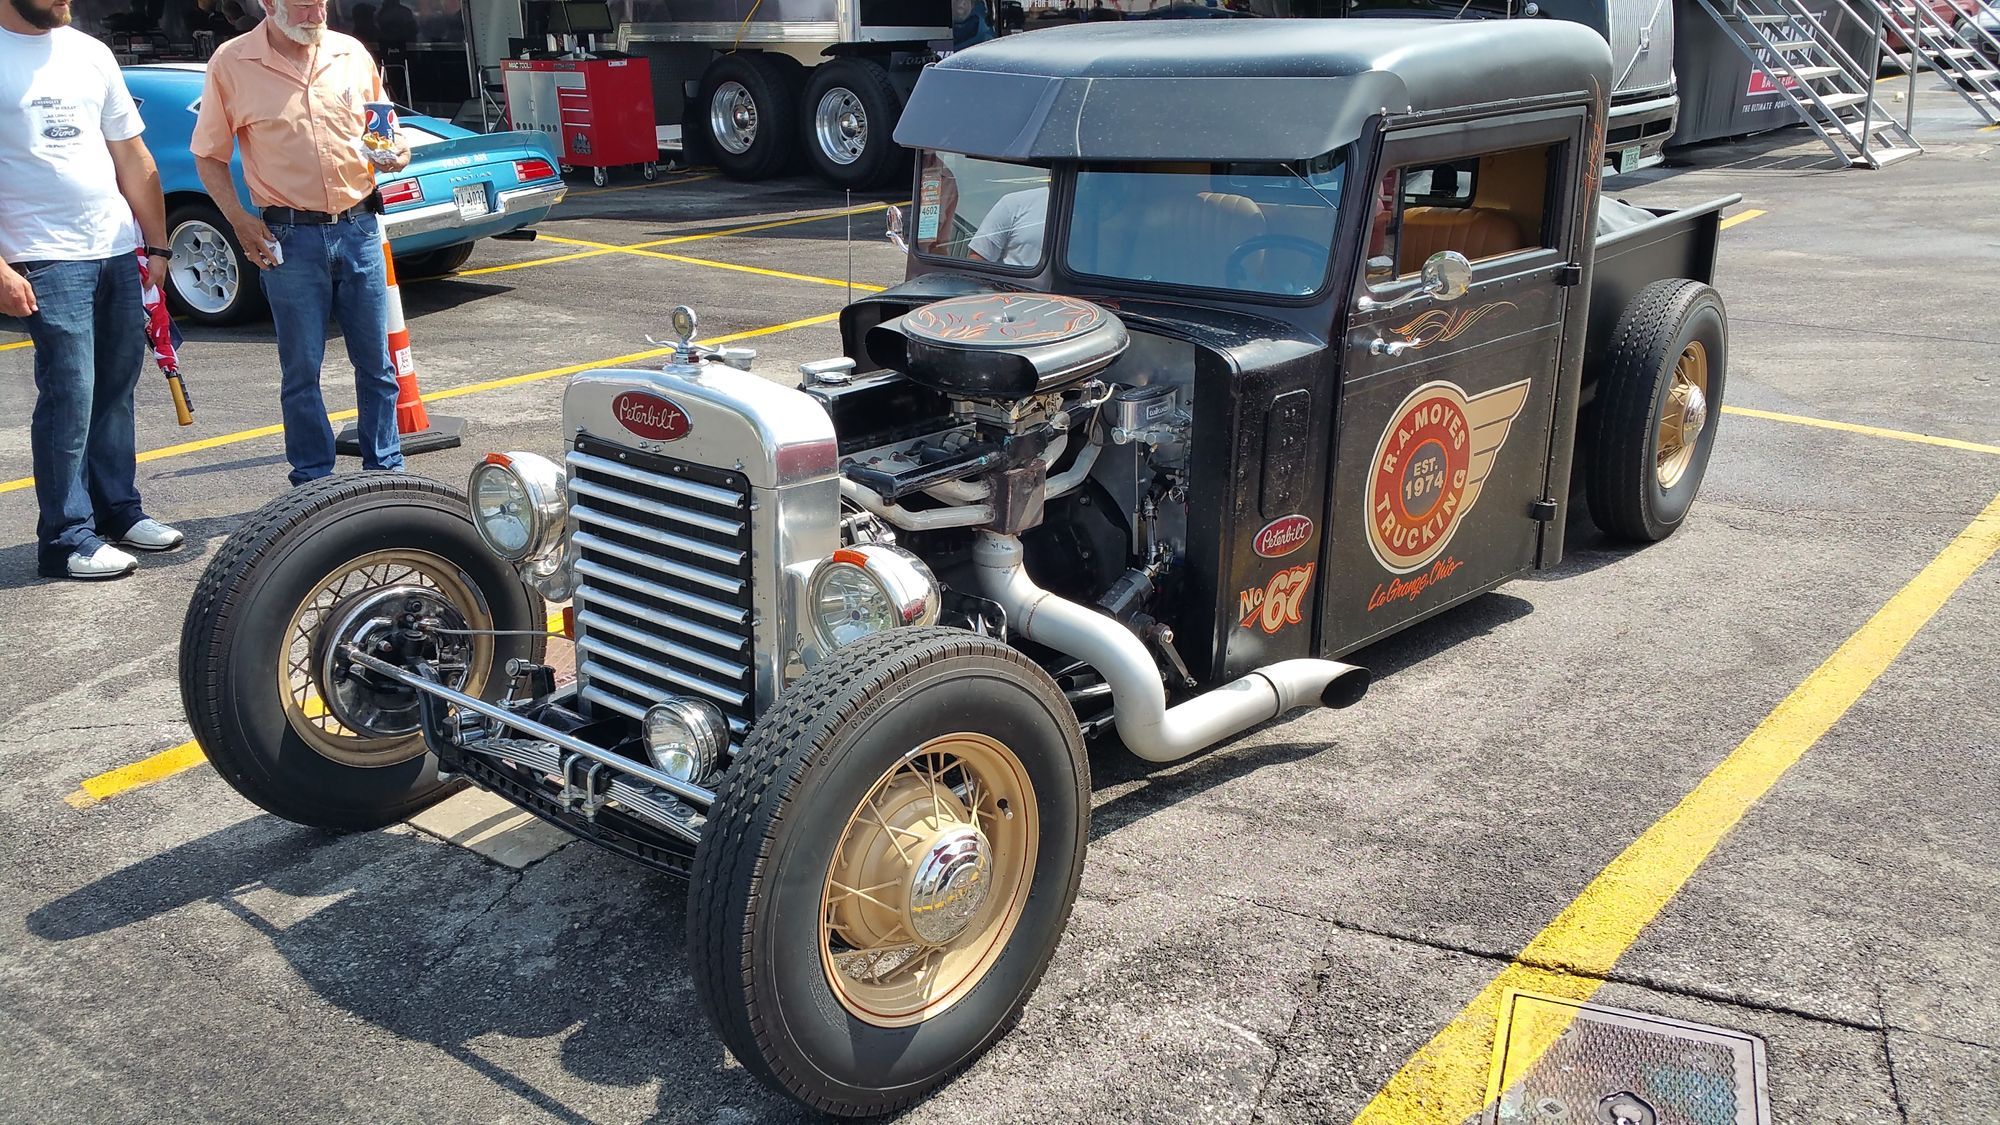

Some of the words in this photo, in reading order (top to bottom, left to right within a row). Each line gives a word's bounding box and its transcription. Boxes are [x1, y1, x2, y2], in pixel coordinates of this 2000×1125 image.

[508, 61, 518, 69] MAC
[519, 61, 533, 69] TOOLS
[1751, 102, 1773, 111] ULTIMATE
[51, 127, 76, 137] Ford
[922, 206, 938, 216] 4602
[620, 396, 681, 430] Peterbilt
[1413, 457, 1438, 477] EST.
[1405, 470, 1444, 500] 1974
[1376, 469, 1466, 550] TRUCKING
[1262, 522, 1310, 552] Peterbilt
[1261, 562, 1315, 634] 67
